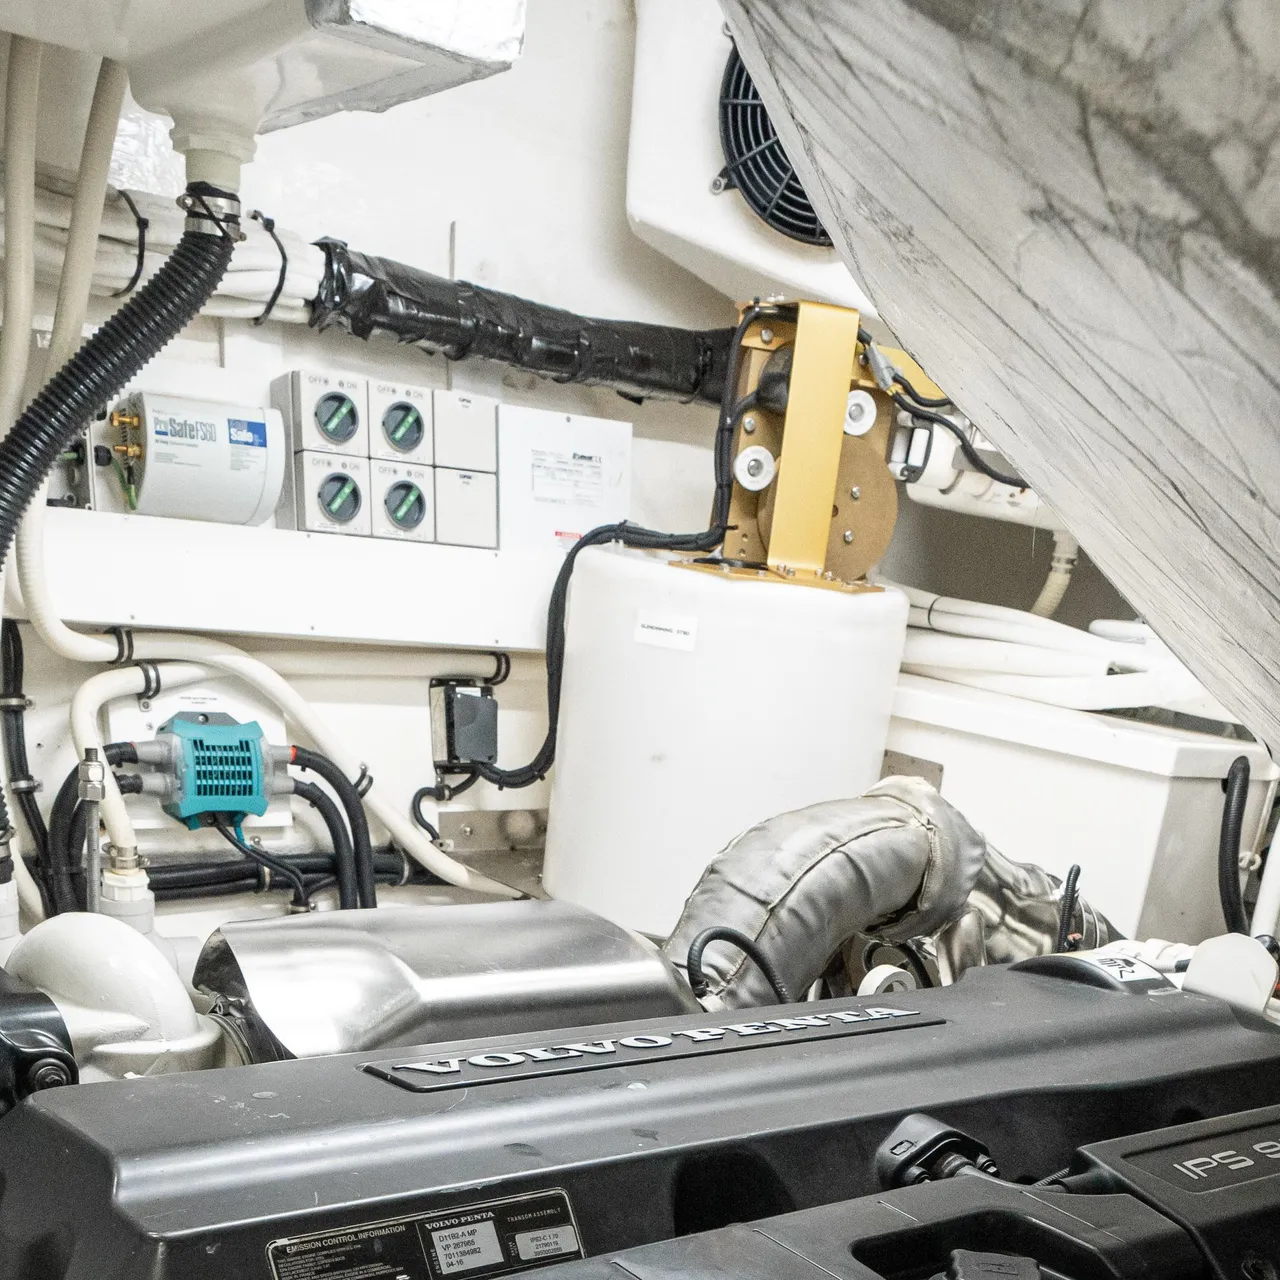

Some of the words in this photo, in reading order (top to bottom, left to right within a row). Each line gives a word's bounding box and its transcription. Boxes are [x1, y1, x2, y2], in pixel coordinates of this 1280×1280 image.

[347, 381, 357, 389] ON
[312, 458, 325, 466] OFF
[392, 1035, 672, 1075] VOLVO
[672, 1006, 922, 1043] PENTA
[1173, 1150, 1254, 1180] IPS
[425, 1219, 458, 1230] VOLVO
[461, 1211, 495, 1223] PENTA
[507, 1212, 532, 1222] TRANSOM
[533, 1208, 561, 1218] ASSEMBLY
[286, 1241, 322, 1254] EMISSION
[322, 1235, 358, 1247] CONTROL
[358, 1225, 406, 1240] INFORMATION
[438, 1232, 466, 1242] D11B2-A
[467, 1229, 478, 1237] MP
